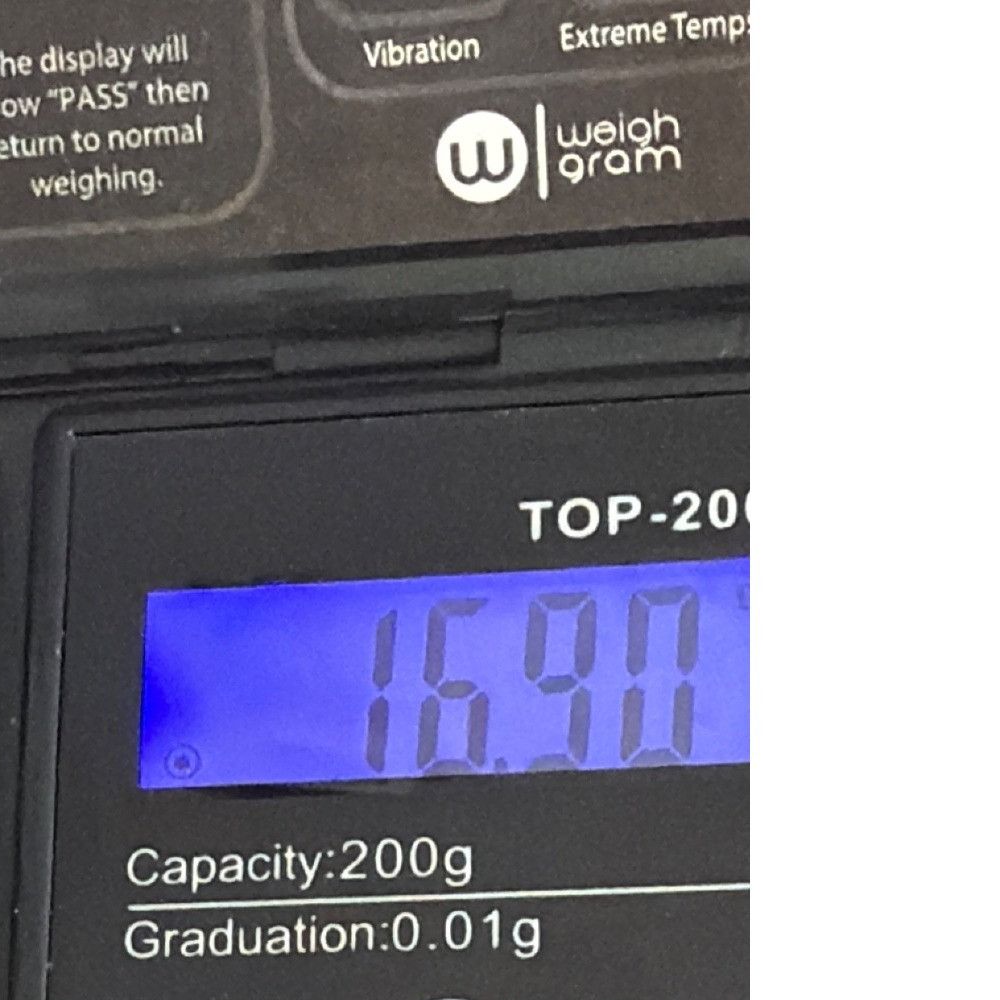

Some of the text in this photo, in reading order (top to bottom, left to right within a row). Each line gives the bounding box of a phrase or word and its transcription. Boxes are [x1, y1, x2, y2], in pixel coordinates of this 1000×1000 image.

[40, 42, 135, 77] display
[141, 34, 190, 65] will
[363, 34, 481, 68] Vibration
[559, 21, 667, 52] Extreme
[145, 78, 210, 107] then
[70, 129, 101, 154] to
[107, 116, 204, 151] normal
[556, 109, 681, 151] weigh
[30, 166, 165, 201] weighing.
[558, 142, 682, 185] gram
[519, 487, 750, 542] TOP-20
[364, 583, 700, 777] 16.90
[125, 836, 475, 893] Capacity:200g
[123, 909, 543, 960] Graduation:0.01g
